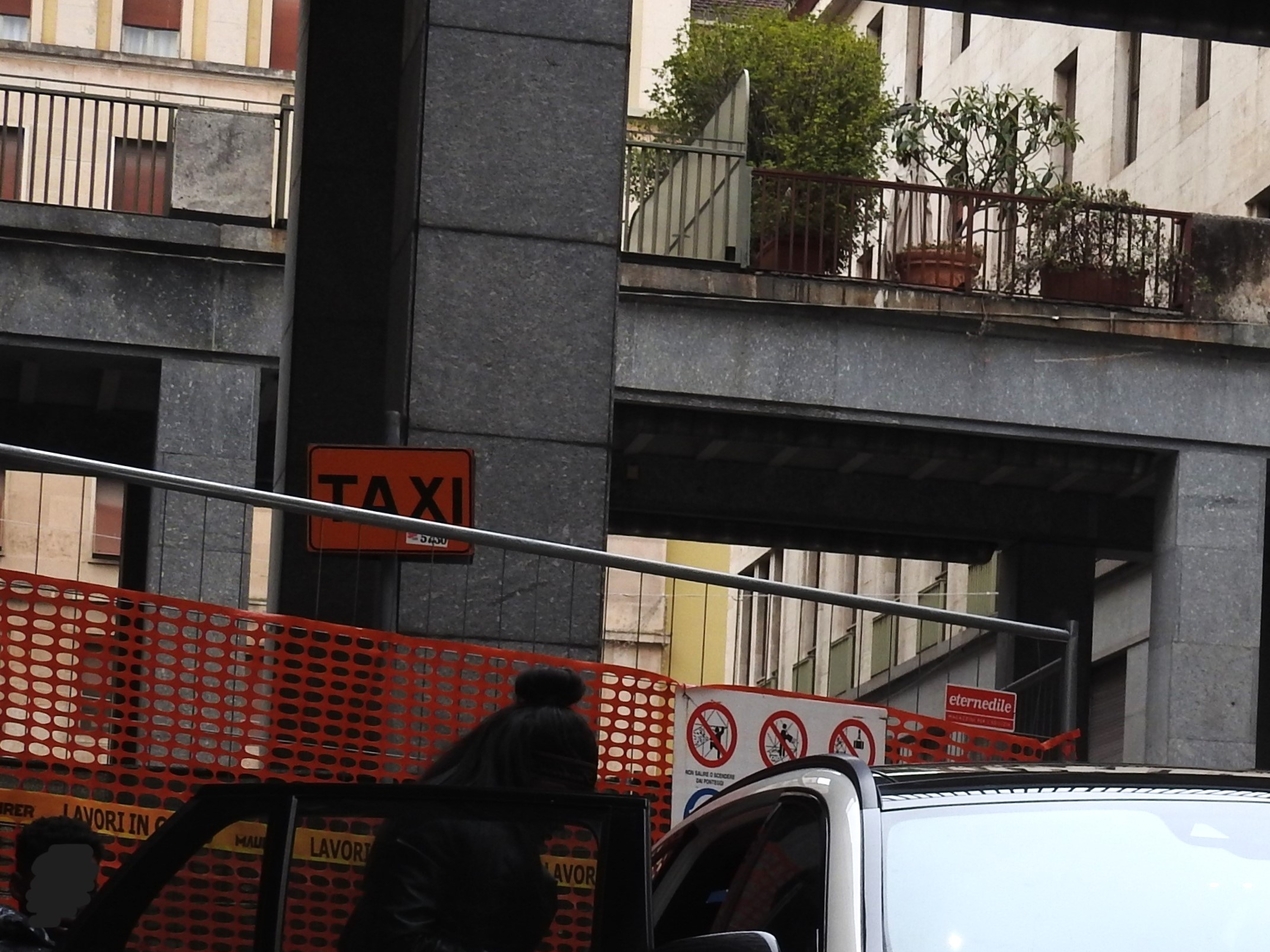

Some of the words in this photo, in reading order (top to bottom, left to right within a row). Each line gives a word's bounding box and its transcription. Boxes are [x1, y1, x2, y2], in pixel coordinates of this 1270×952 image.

[318, 474, 463, 524] TAXI
[949, 693, 1012, 713] eternedile
[129, 813, 149, 836] IN
